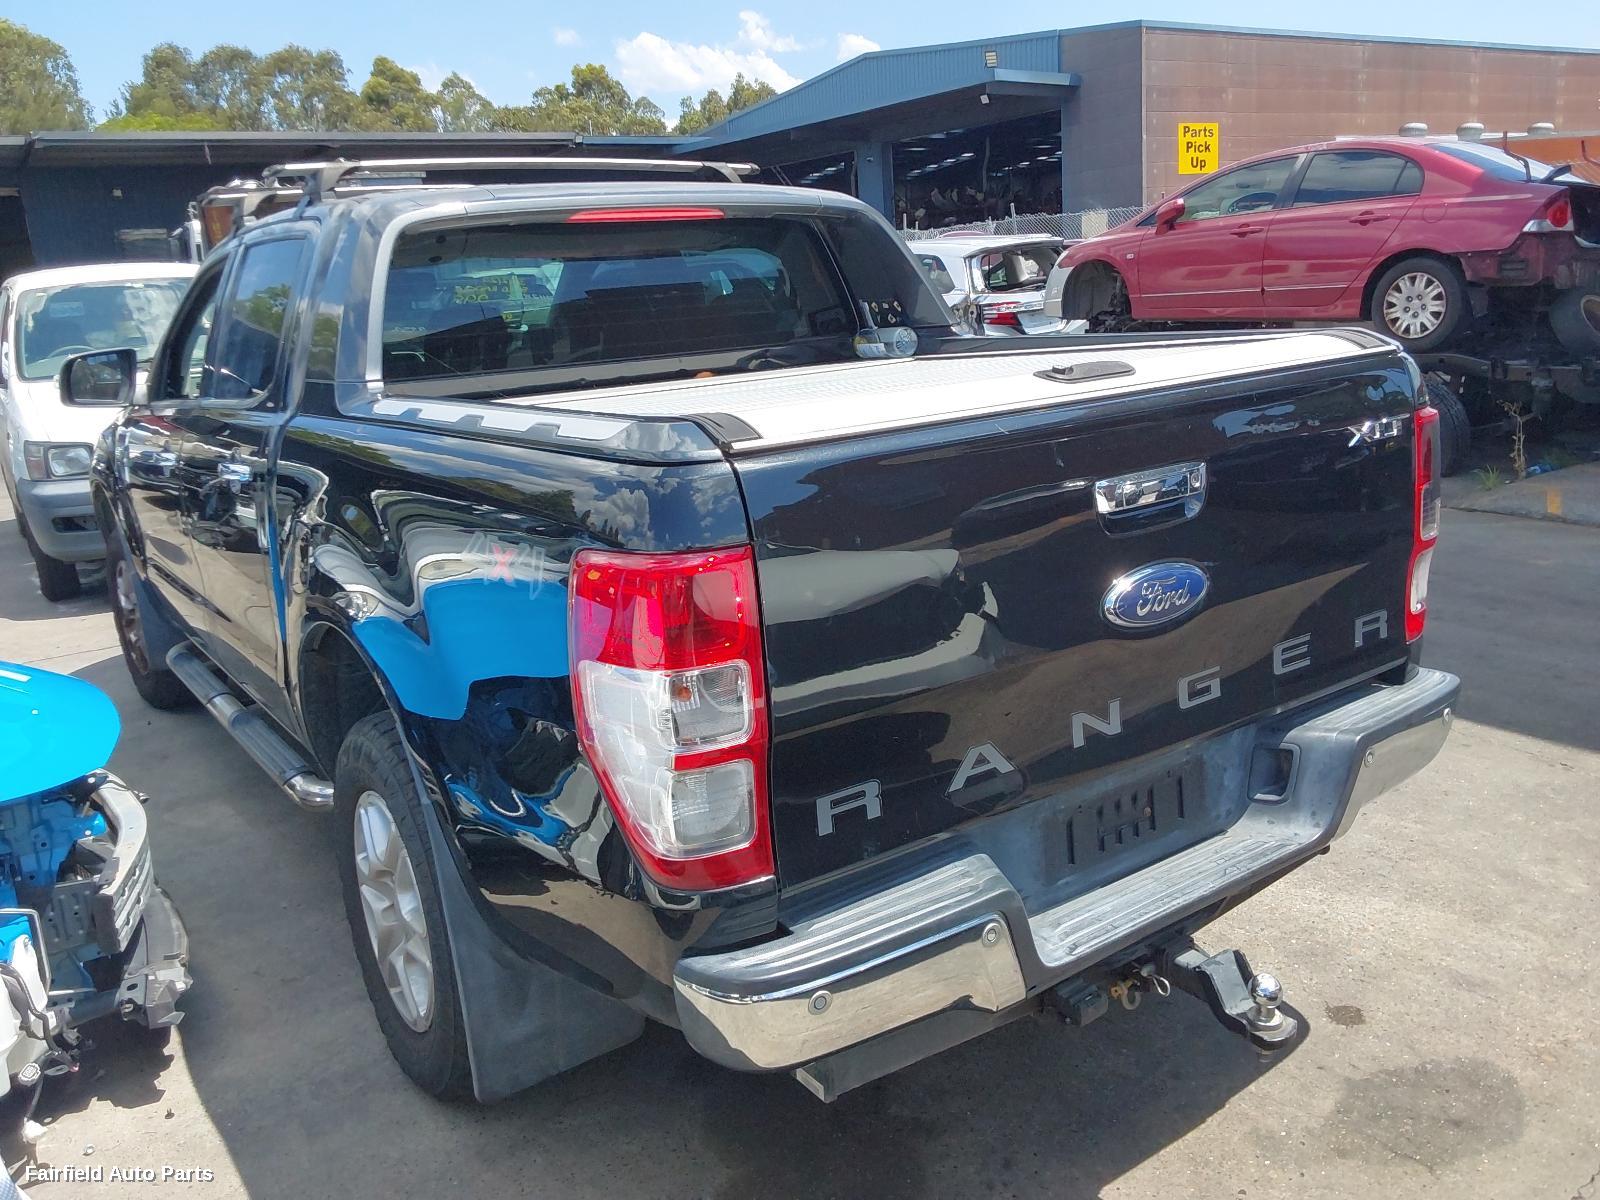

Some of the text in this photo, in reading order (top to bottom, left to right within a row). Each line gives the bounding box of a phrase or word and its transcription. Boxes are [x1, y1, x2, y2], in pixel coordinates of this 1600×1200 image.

[1183, 125, 1214, 138] Parts
[1186, 140, 1211, 154] Pick
[1190, 156, 1207, 171] Up
[1136, 575, 1191, 617] Ford
[815, 608, 1391, 837] RANGER
